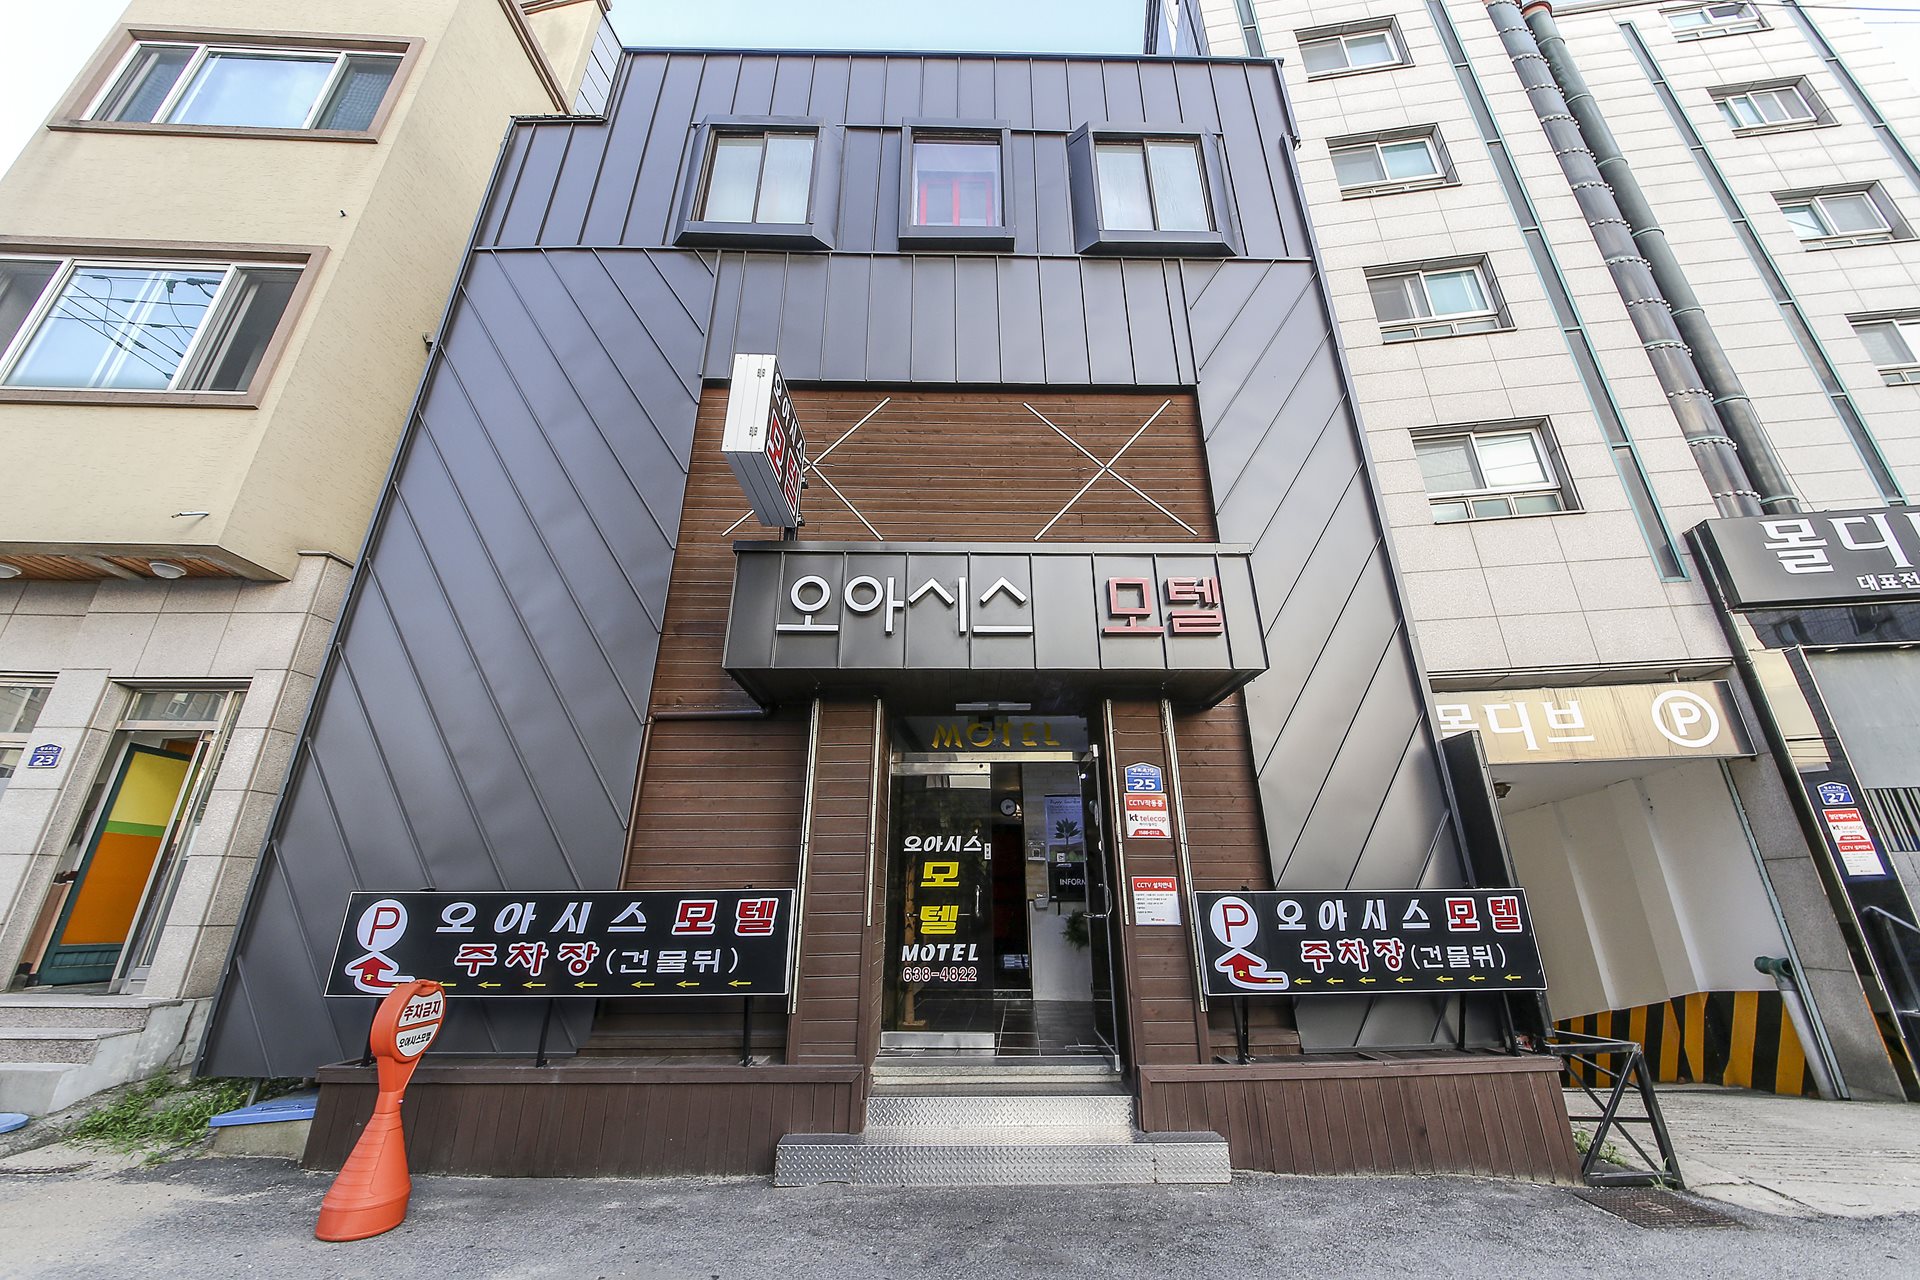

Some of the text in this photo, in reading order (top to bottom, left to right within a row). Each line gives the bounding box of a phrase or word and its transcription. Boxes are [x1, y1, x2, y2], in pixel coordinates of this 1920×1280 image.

[766, 408, 801, 517] 모텔
[1758, 512, 1920, 574] 몰디
[776, 574, 1224, 636] 오아시스 모텔
[1669, 701, 1702, 736] P
[931, 722, 1060, 749] MOTEL
[33, 755, 55, 766] 23
[1133, 779, 1156, 790] 25
[1826, 793, 1845, 803] 27
[1129, 814, 1167, 824] kt telecop
[903, 835, 983, 853] 오아시스
[368, 906, 400, 945] P
[435, 898, 779, 937] 오아시스 모텔
[1221, 904, 1249, 942] P
[1276, 895, 1524, 933] 오아시스 모텔
[901, 943, 980, 962] MOTEL
[902, 966, 978, 982] 638-4822
[404, 1000, 441, 1021] 주차금지
[399, 1031, 432, 1048] 오아시스모텔
